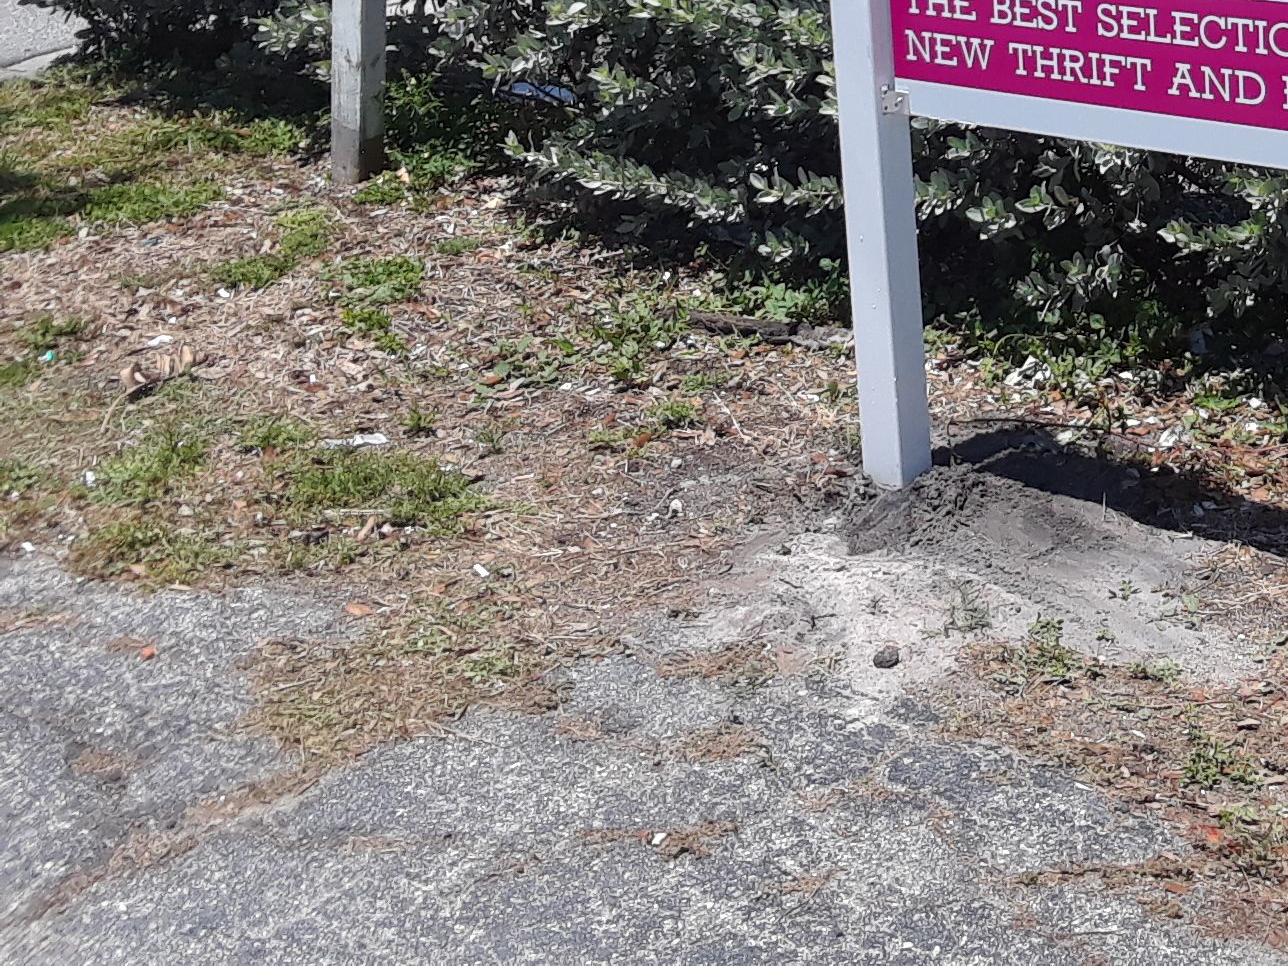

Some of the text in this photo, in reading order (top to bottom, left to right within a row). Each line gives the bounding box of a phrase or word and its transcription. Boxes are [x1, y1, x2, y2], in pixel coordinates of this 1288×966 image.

[904, 30, 994, 71] NEW
[1008, 42, 1151, 90] THRIFT
[1167, 62, 1266, 105] AND
